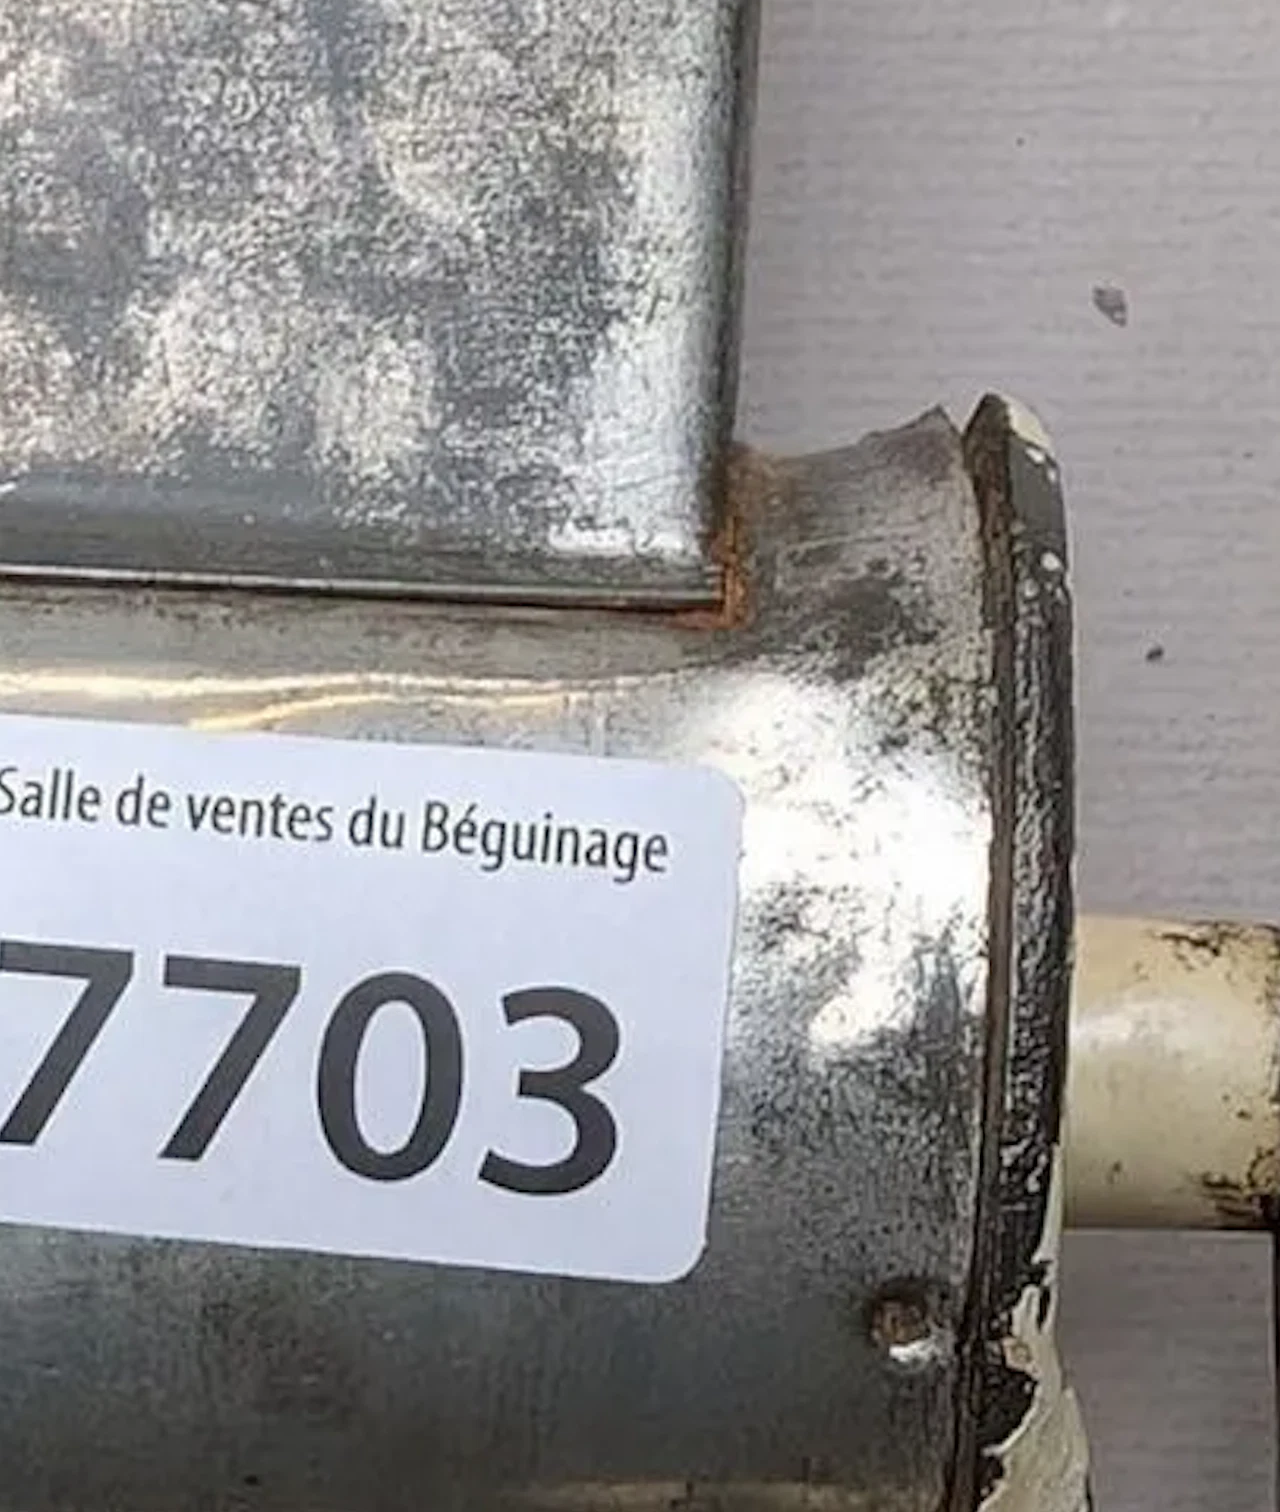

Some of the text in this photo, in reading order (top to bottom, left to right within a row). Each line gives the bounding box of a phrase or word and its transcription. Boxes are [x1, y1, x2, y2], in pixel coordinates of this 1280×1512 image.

[116, 774, 172, 828] de
[187, 793, 334, 843] ventes
[348, 795, 405, 849] du
[422, 801, 668, 885] Béguinage
